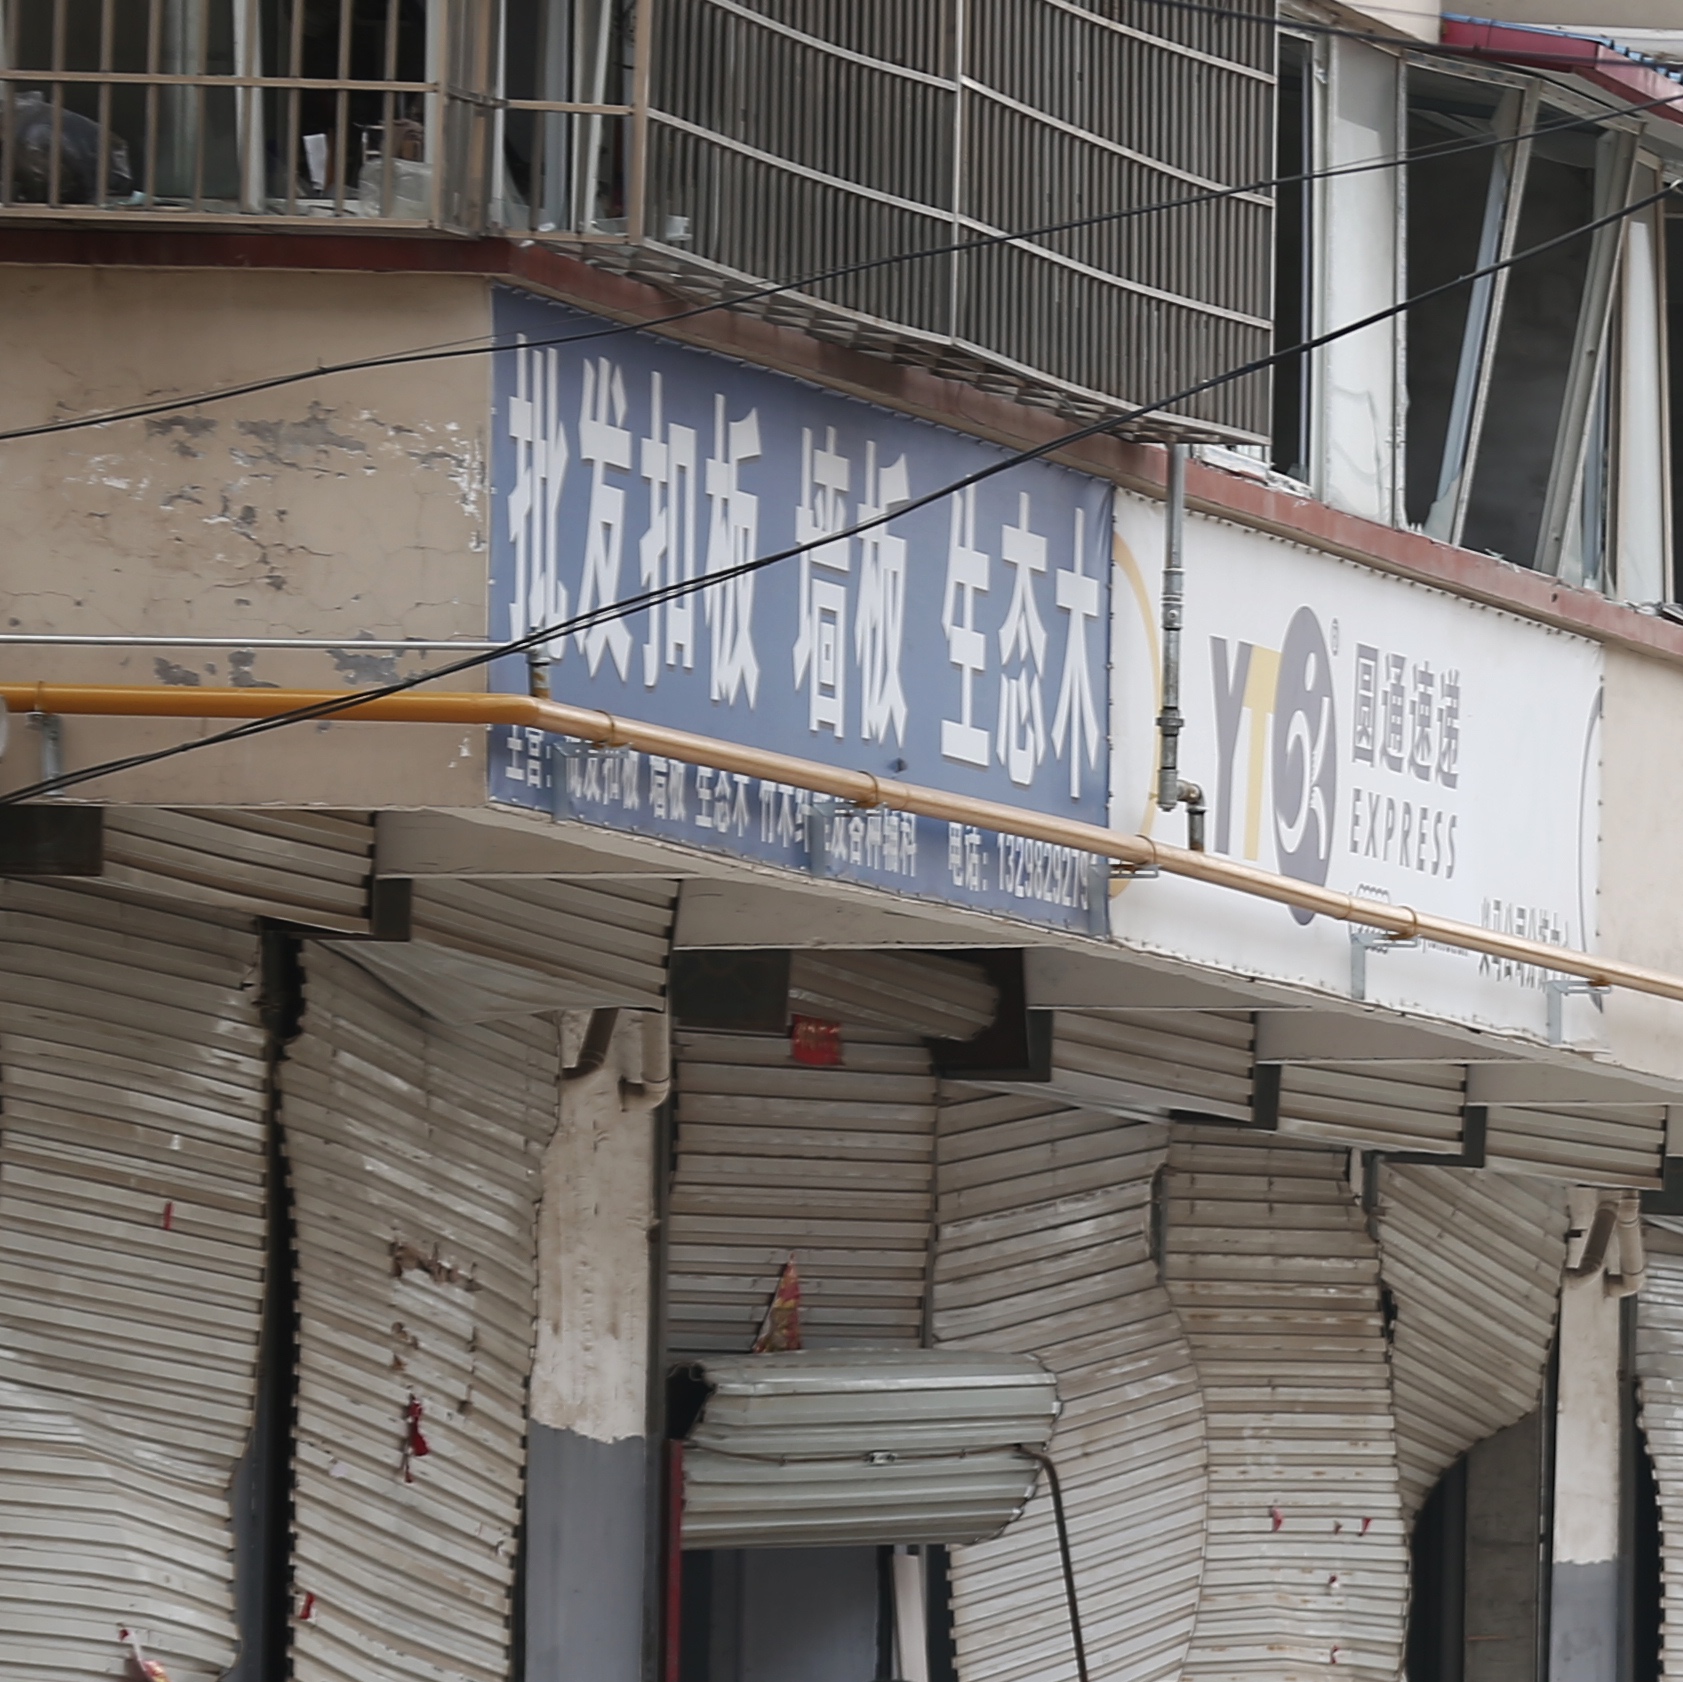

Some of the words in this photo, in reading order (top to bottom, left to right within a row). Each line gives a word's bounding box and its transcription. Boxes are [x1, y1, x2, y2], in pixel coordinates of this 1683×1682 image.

[507, 333, 761, 709] 批发扣板
[793, 426, 911, 748] 墙板
[941, 473, 1100, 800] 生态木
[1352, 642, 1461, 790] 圆通速递
[1349, 787, 1459, 880] EXPRESS
